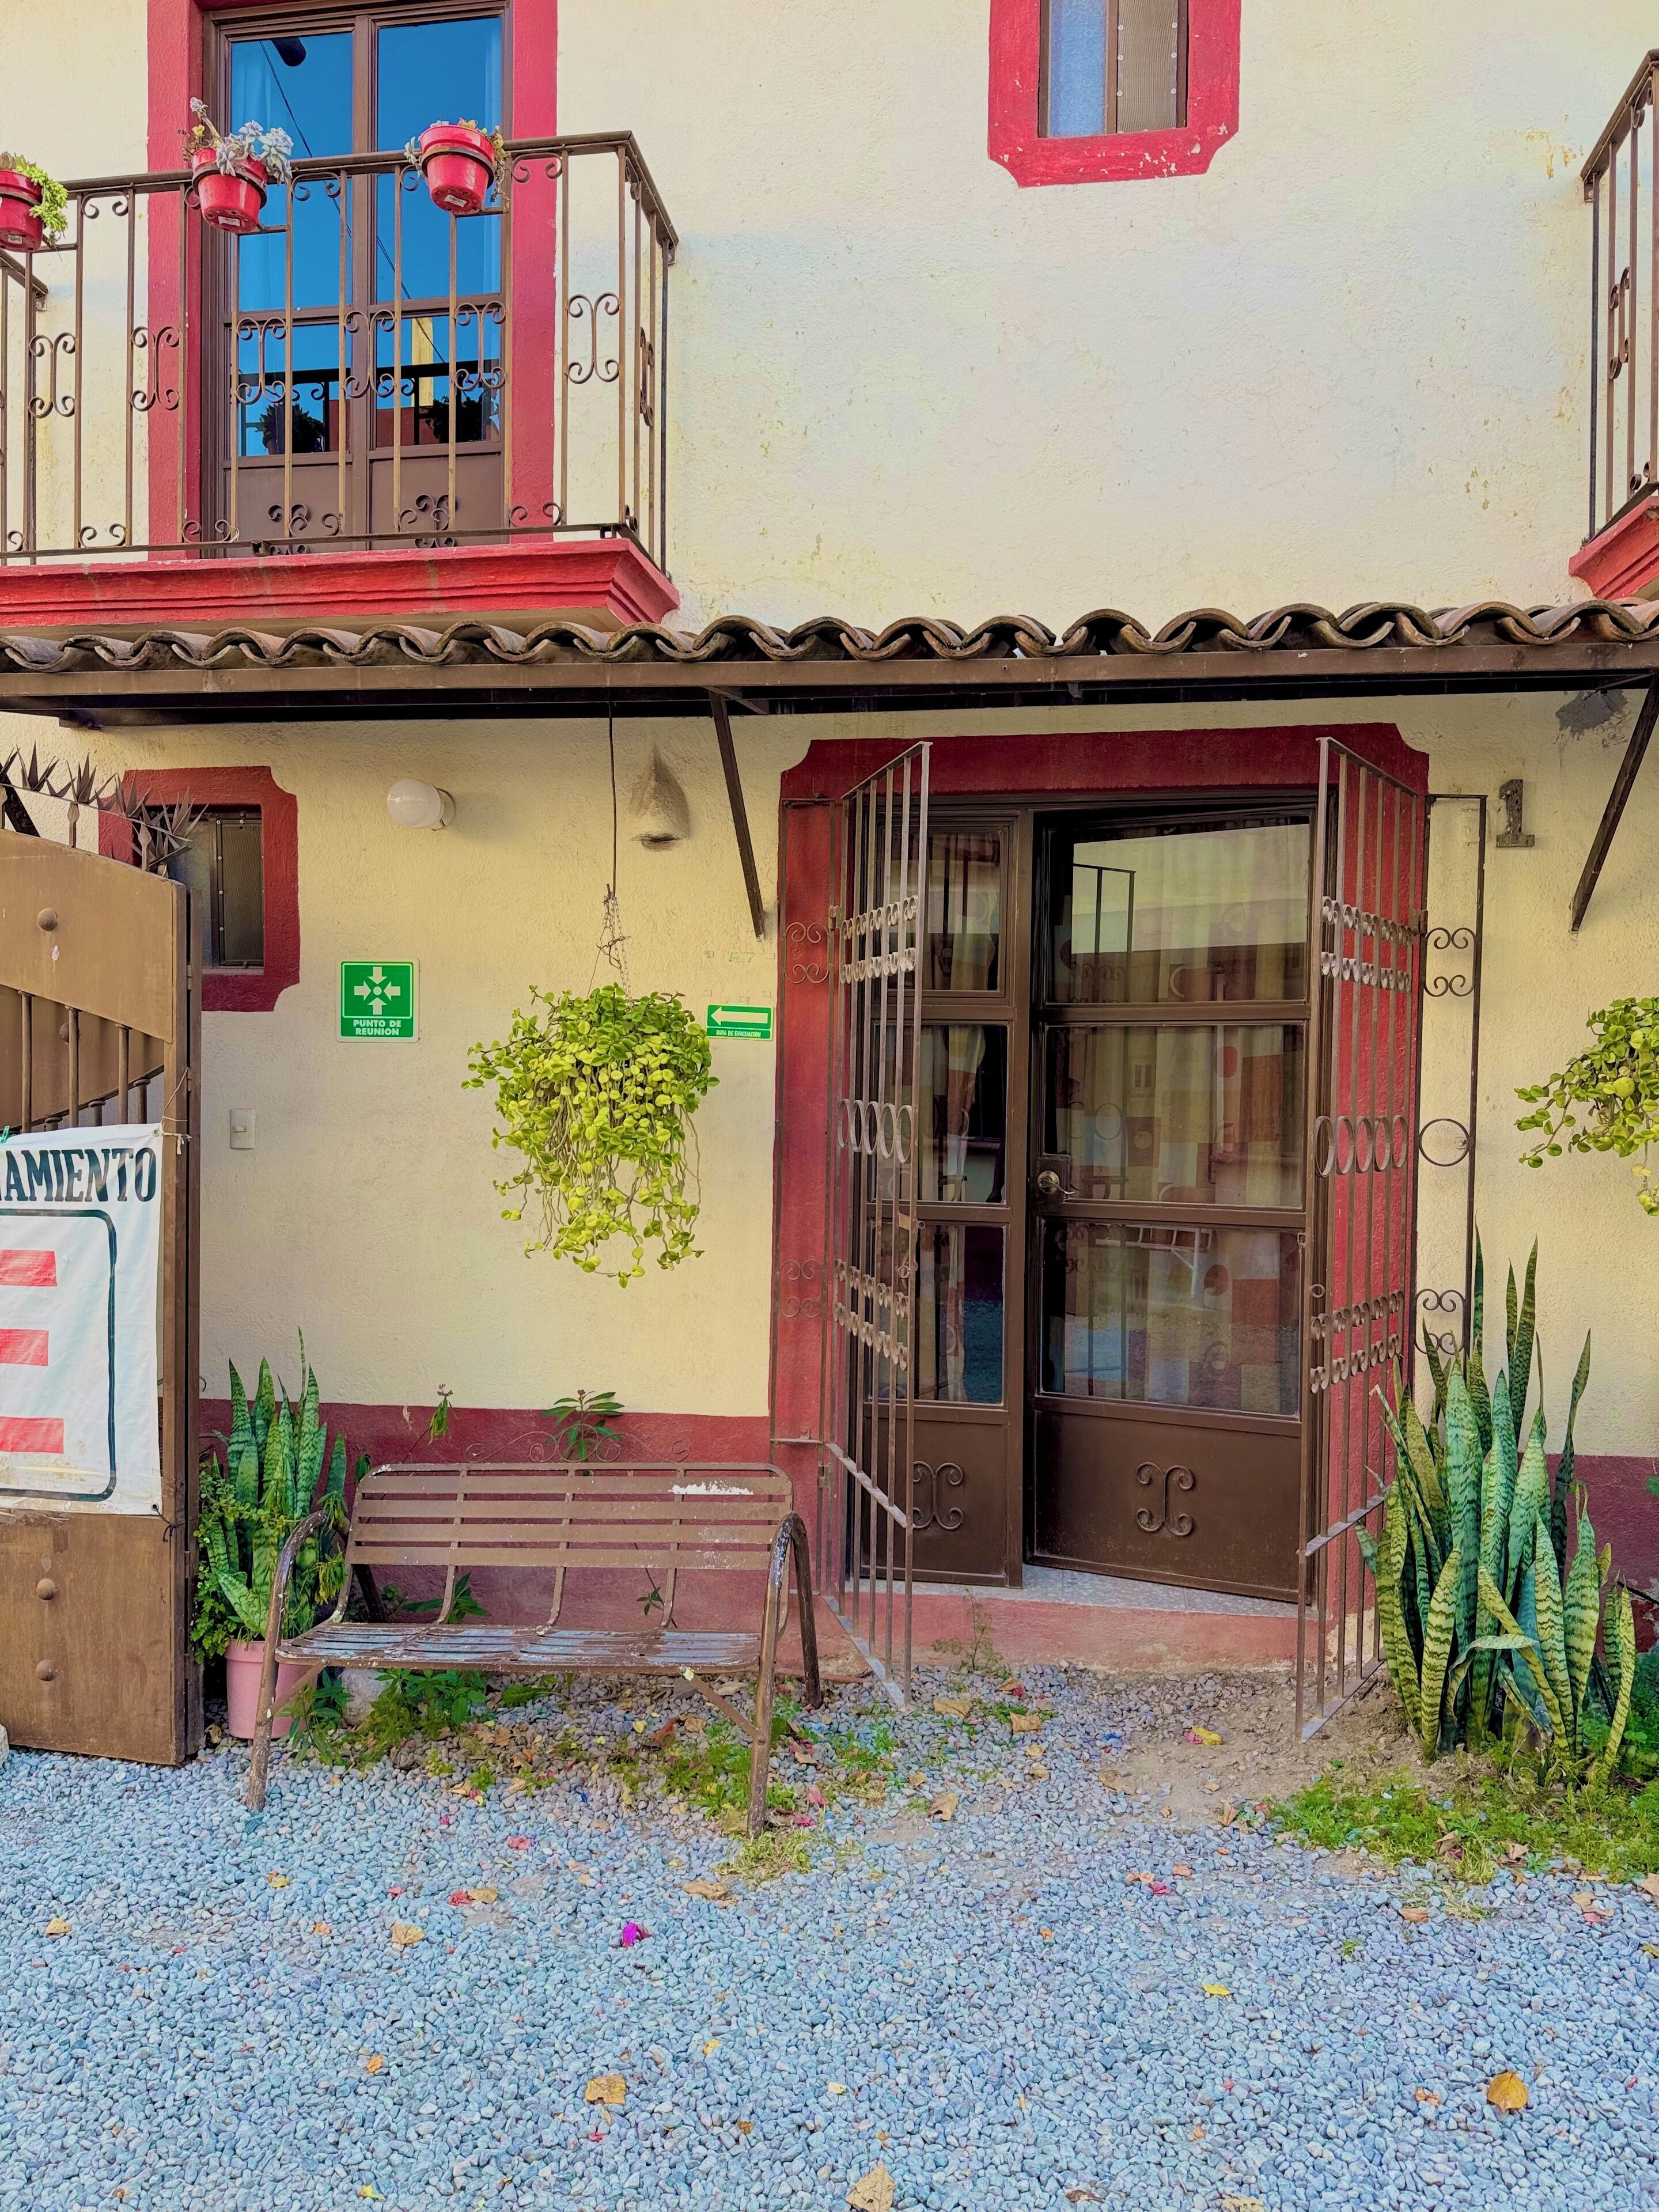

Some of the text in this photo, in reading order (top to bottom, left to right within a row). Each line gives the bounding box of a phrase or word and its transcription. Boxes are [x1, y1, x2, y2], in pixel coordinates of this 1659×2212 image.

[1496, 779, 1535, 847] 1
[355, 1028, 399, 1036] REUNION
[0, 1147, 156, 1202] AMIENTO
